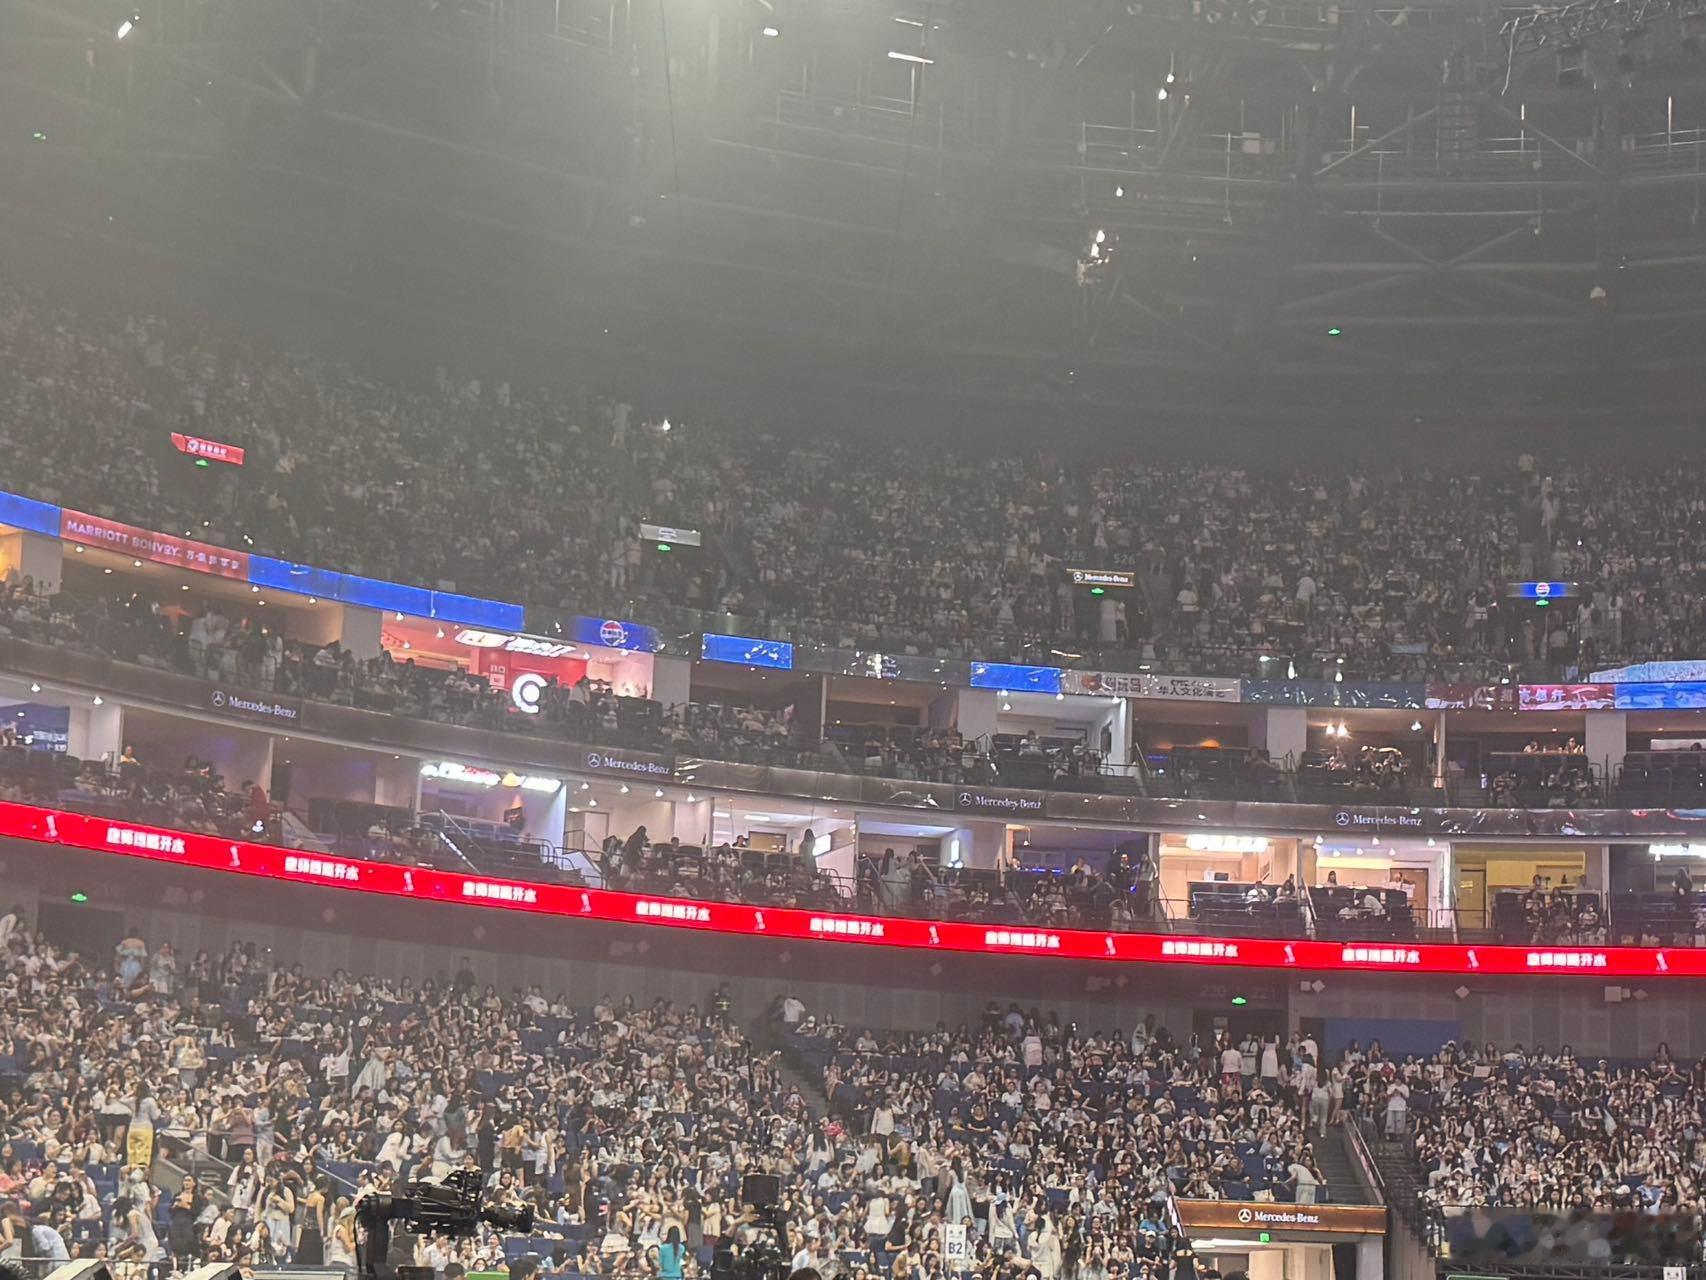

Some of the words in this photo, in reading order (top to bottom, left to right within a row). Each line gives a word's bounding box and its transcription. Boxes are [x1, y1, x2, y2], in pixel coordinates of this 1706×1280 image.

[67, 520, 128, 542] MARRIOTT
[228, 695, 297, 718] Mercedes-Benz
[603, 756, 670, 774] Mercedes-Benz
[975, 795, 1042, 810] Mercedes-Benz
[1353, 814, 1422, 826] Mercedes-Benz
[1254, 1210, 1319, 1224] Mercedes-Benz
[948, 1241, 963, 1255] B2
